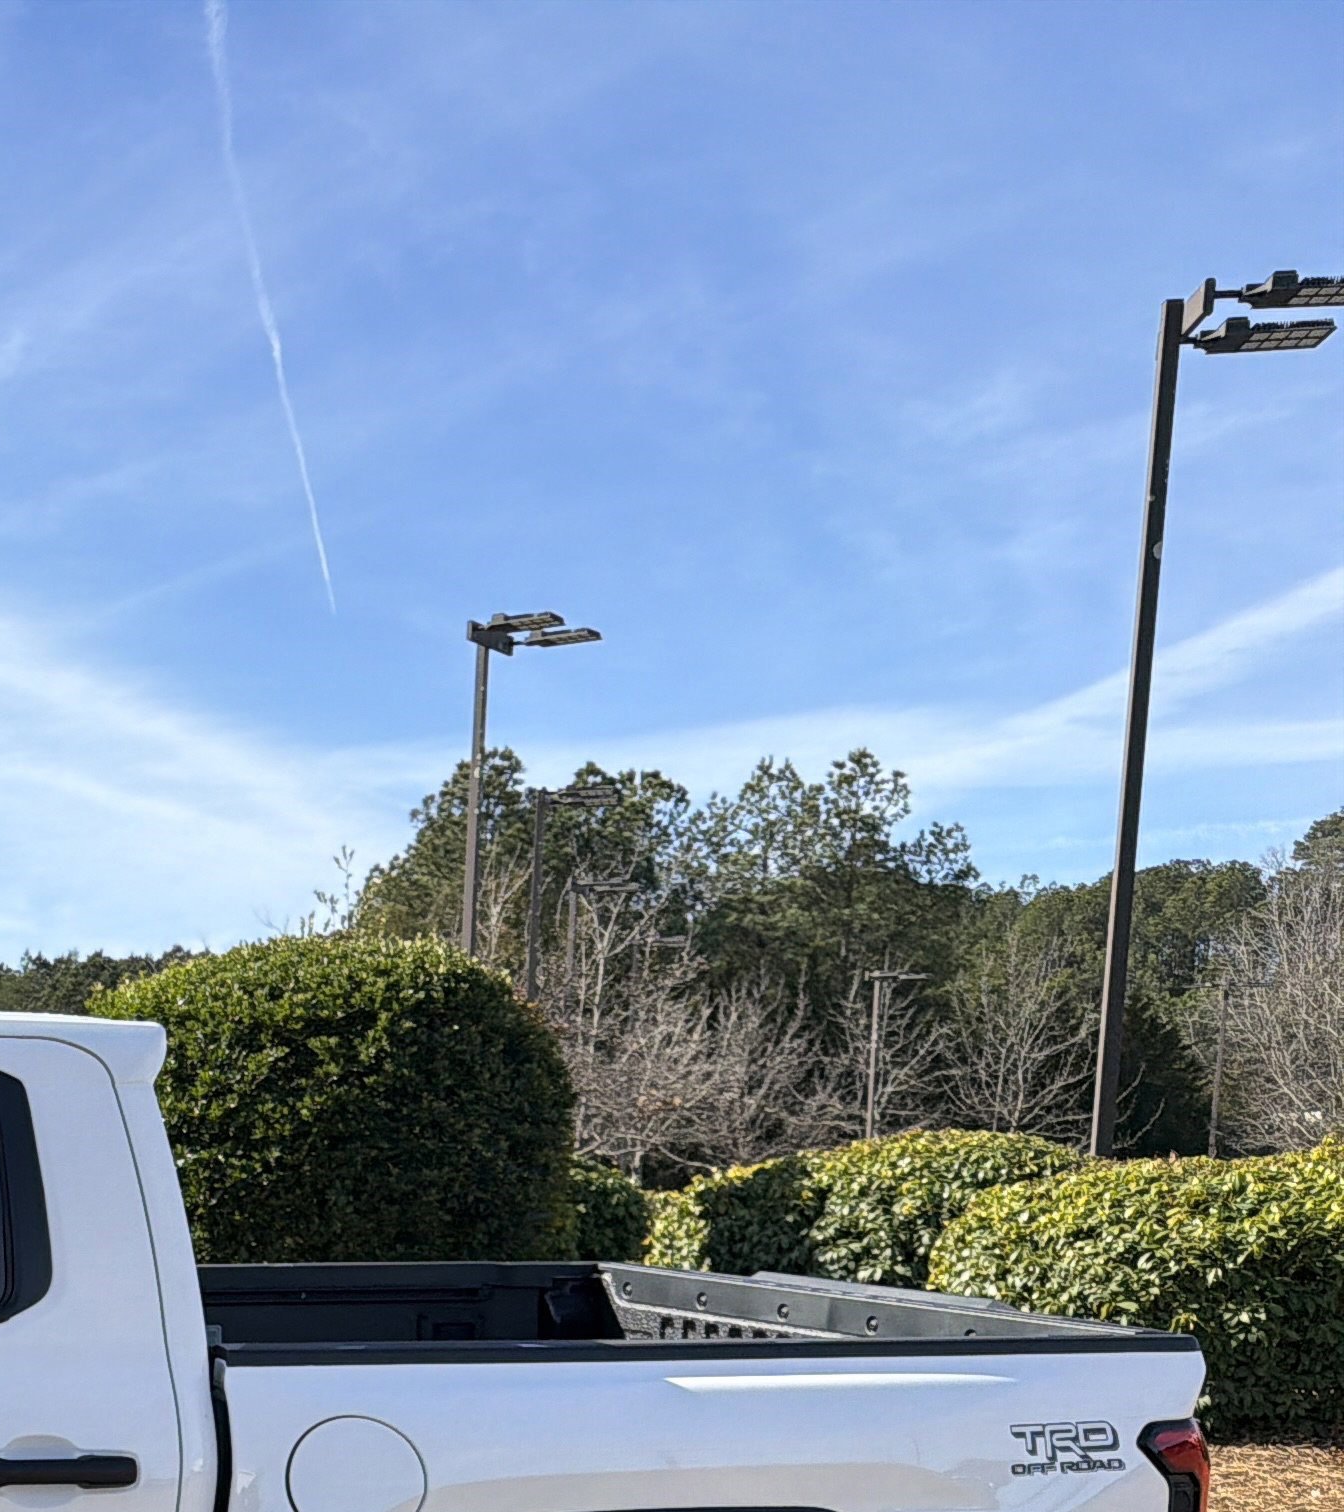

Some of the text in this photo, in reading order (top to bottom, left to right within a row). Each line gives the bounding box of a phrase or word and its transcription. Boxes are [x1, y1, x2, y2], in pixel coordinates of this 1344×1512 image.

[1010, 1420, 1120, 1462] TRD
[1011, 1458, 1127, 1477] OFF ROAD
